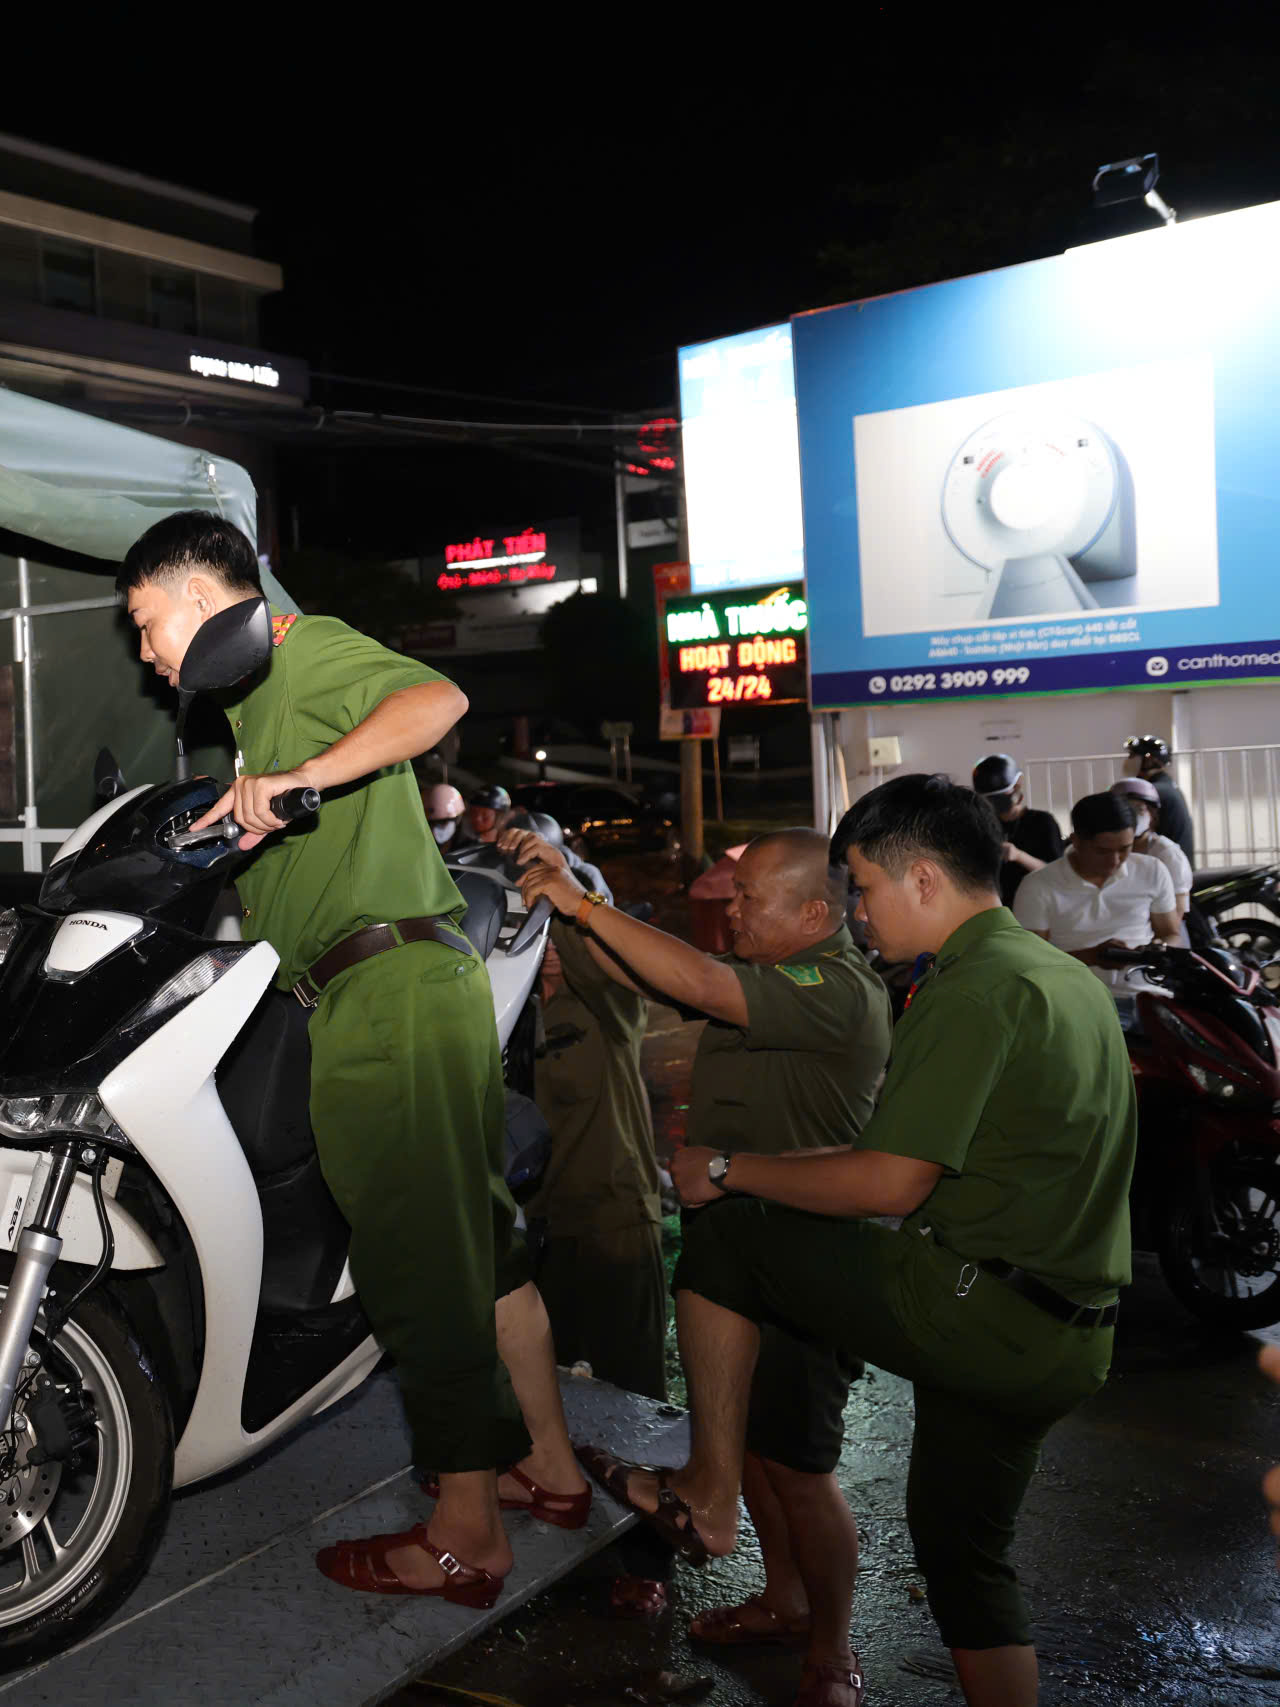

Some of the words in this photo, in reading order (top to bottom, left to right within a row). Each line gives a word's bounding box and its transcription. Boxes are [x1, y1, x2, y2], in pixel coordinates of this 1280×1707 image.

[445, 537, 495, 563] PHÁT
[667, 602, 720, 642] NHÀ
[725, 592, 808, 637] THUỐC
[680, 644, 730, 674] HOẠT
[738, 635, 797, 671] ĐỘNG
[707, 674, 772, 702] 24/24
[890, 673, 937, 692] 0292
[941, 669, 988, 690] 3909
[991, 666, 1030, 686] 999
[68, 919, 108, 931] HONDA
[7, 1196, 23, 1243] ABS
